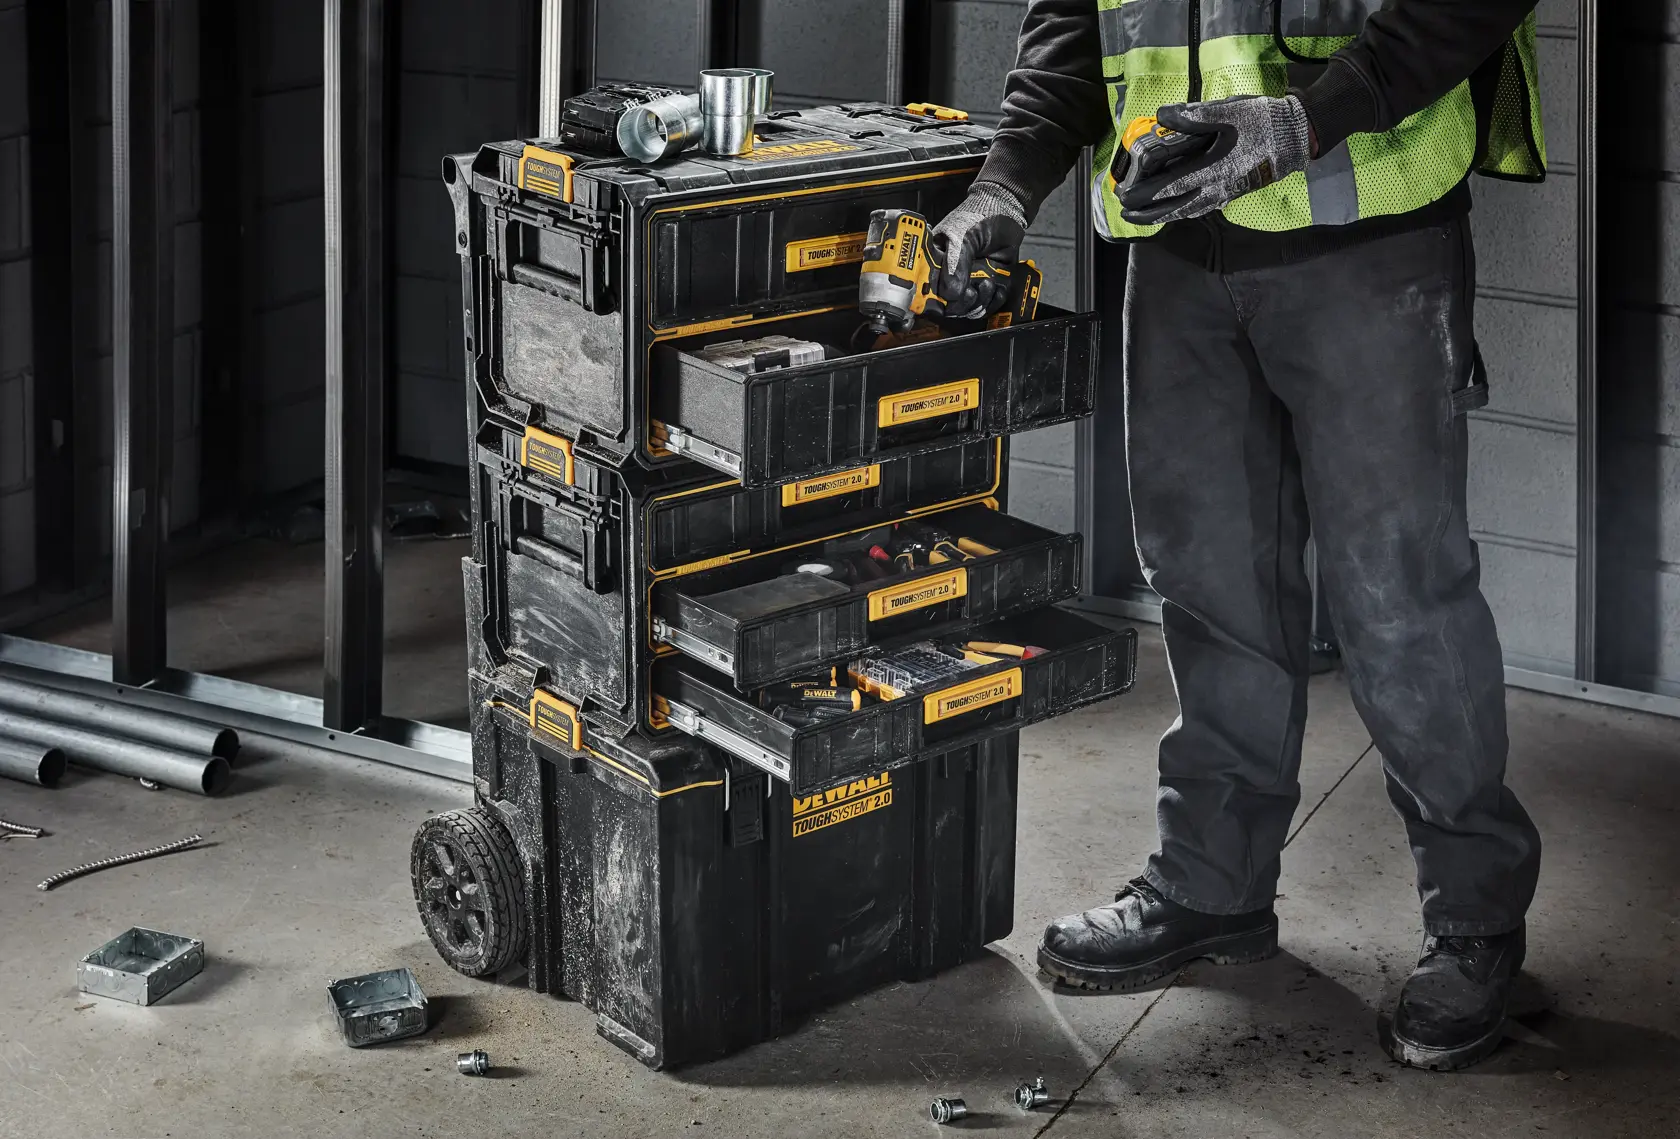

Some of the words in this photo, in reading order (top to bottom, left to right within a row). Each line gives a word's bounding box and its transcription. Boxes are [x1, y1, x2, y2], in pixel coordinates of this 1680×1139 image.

[899, 231, 912, 268] DEWALT
[901, 397, 947, 414] TOUGHSYSTEM
[949, 394, 960, 404] 2.0
[804, 478, 850, 495] TOUGHSYSTEM
[851, 474, 862, 485] 2.0
[891, 588, 937, 608] TOUGHSYSTEM
[938, 584, 949, 595] 2.0
[803, 689, 837, 698] DEWALT
[946, 689, 992, 711] TOUGHSYSTEM
[993, 685, 1004, 696] 2.0
[794, 799, 872, 835] TOUGHSYSTEM
[874, 791, 891, 808] 2.0
